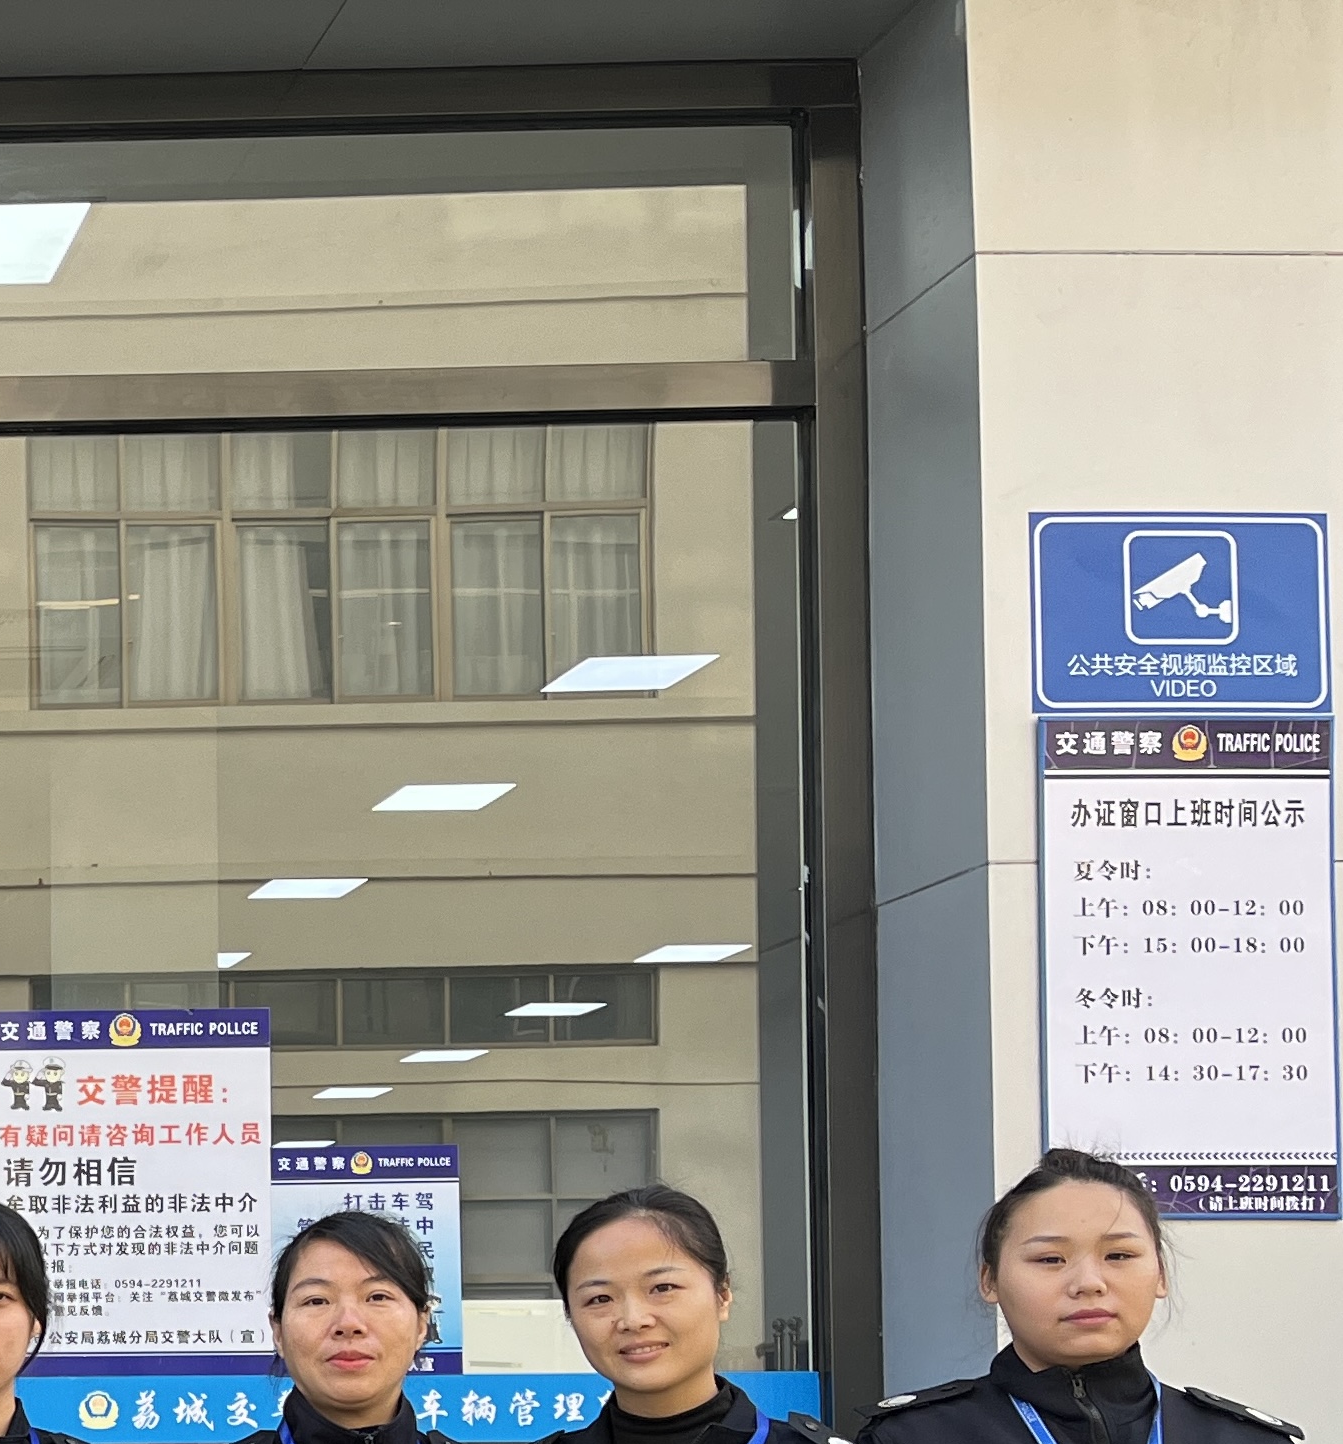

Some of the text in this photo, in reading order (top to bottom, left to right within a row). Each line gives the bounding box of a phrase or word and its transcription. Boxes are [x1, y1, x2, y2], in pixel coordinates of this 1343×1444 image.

[1067, 653, 1298, 677] 公共安全视频监控区域
[1150, 679, 1217, 697] VIDEO
[1055, 731, 1321, 755] 交通警察 TRAFFIC POLICE
[1070, 798, 1305, 828] 办证窗口上班时间公示
[0, 1020, 101, 1041] 交通警察
[149, 1022, 204, 1036] TRAFFIC
[3, 1157, 137, 1187] 请勿相信
[277, 1157, 346, 1172] 交通警察
[377, 1157, 415, 1168] TRAFFIC
[6, 1192, 258, 1215] 牟取非法利益的非法中介
[344, 1192, 434, 1211] 打击车驾
[131, 1388, 610, 1431] 荔城交 车辆管理
